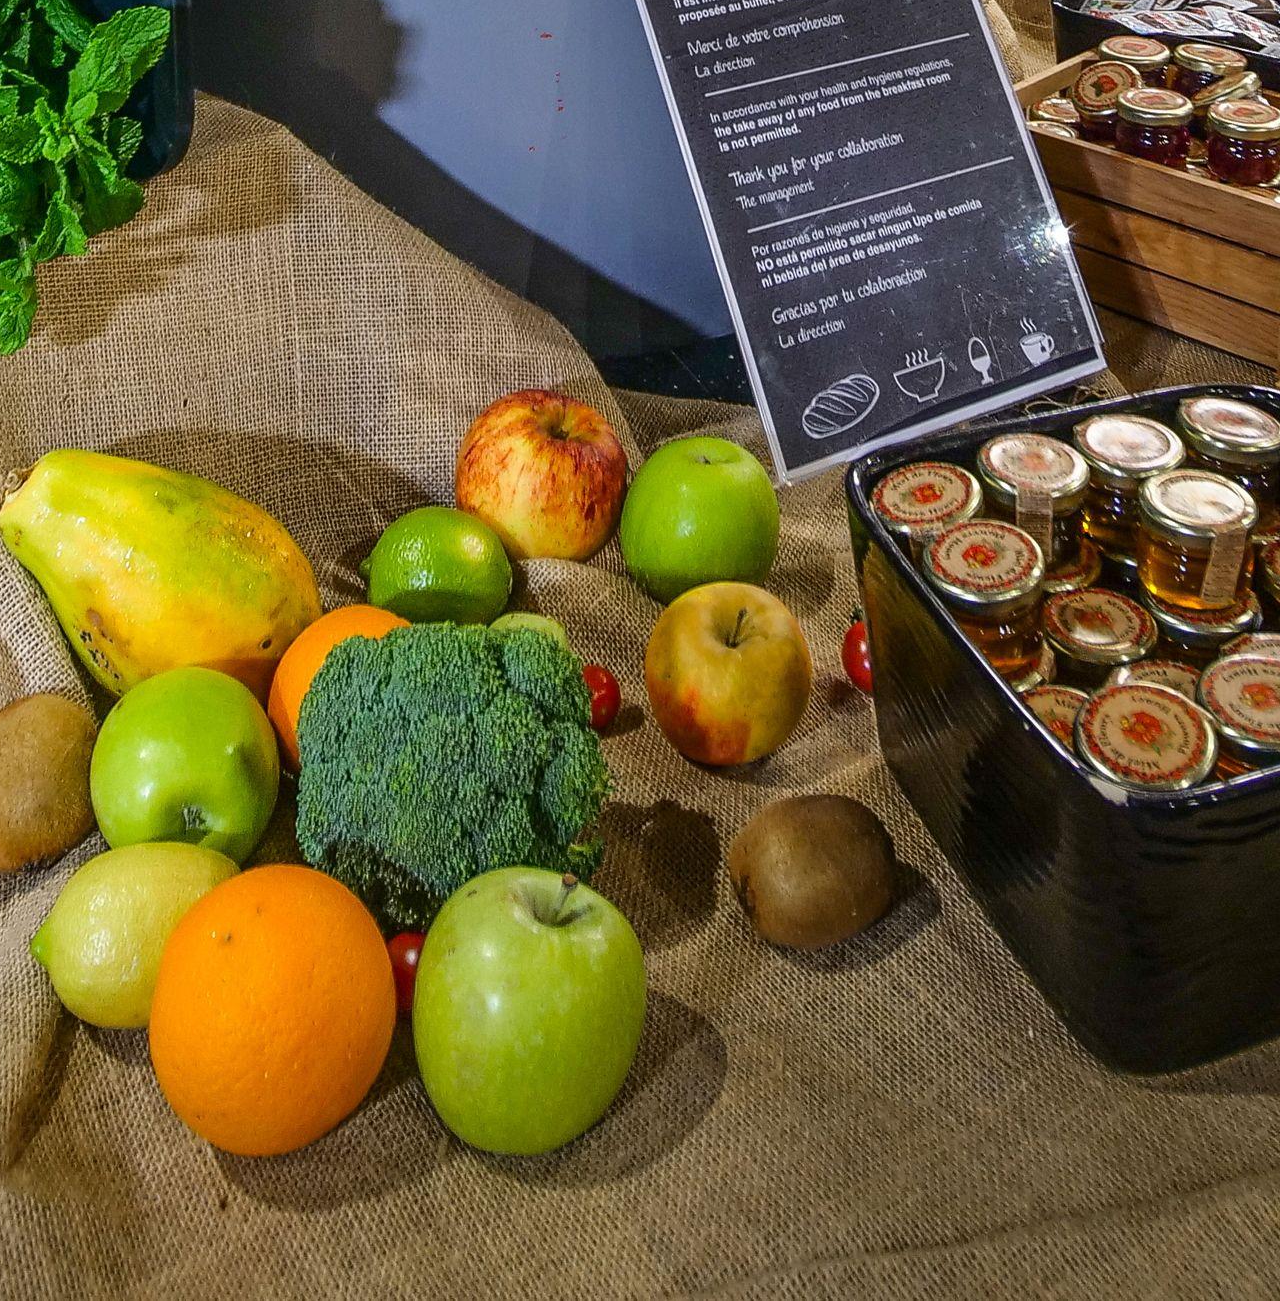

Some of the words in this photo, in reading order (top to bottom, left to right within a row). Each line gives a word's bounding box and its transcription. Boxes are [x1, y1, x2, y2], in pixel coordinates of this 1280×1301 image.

[678, 4, 727, 25] proposée
[727, 2, 742, 13] au
[686, 37, 723, 57] Merci
[725, 32, 740, 49] de
[741, 28, 771, 45] votre
[772, 13, 845, 38] compréhension
[694, 65, 712, 78] La
[713, 56, 756, 75] direction
[709, 112, 721, 124] In
[722, 100, 777, 122] accordance
[777, 93, 798, 107] with
[798, 89, 819, 105] your
[819, 81, 850, 98] health
[850, 76, 868, 90] and
[867, 70, 904, 87] hygiene
[713, 126, 732, 138] the
[732, 120, 756, 134] take
[757, 113, 783, 128] away
[785, 108, 796, 121] of
[797, 105, 816, 118] any
[816, 97, 841, 113] food
[840, 94, 865, 107] from
[864, 89, 882, 101] the
[880, 77, 926, 97] breakfast
[925, 73, 952, 86] room
[730, 135, 750, 150] not
[750, 122, 802, 148] permitted.
[727, 165, 766, 187] Thank
[767, 162, 789, 184] you
[790, 156, 807, 176] for
[810, 150, 835, 172] your
[837, 133, 905, 159] collaboration
[735, 194, 758, 210] The
[758, 177, 816, 205] management
[751, 244, 770, 258] Por
[811, 228, 825, 241] de
[824, 219, 860, 237] higiene
[860, 216, 867, 229] y
[755, 257, 775, 273] NO
[775, 250, 799, 268] está
[799, 237, 848, 263] permitido
[849, 229, 877, 246] sacar
[933, 208, 947, 221] de
[947, 198, 983, 217] comida
[772, 265, 810, 285] bebida
[810, 258, 828, 274] del
[828, 253, 852, 269] área
[852, 248, 866, 261] de
[771, 301, 818, 325] Gracias
[818, 294, 839, 315] por
[841, 288, 856, 304] tu
[778, 334, 796, 349] La
